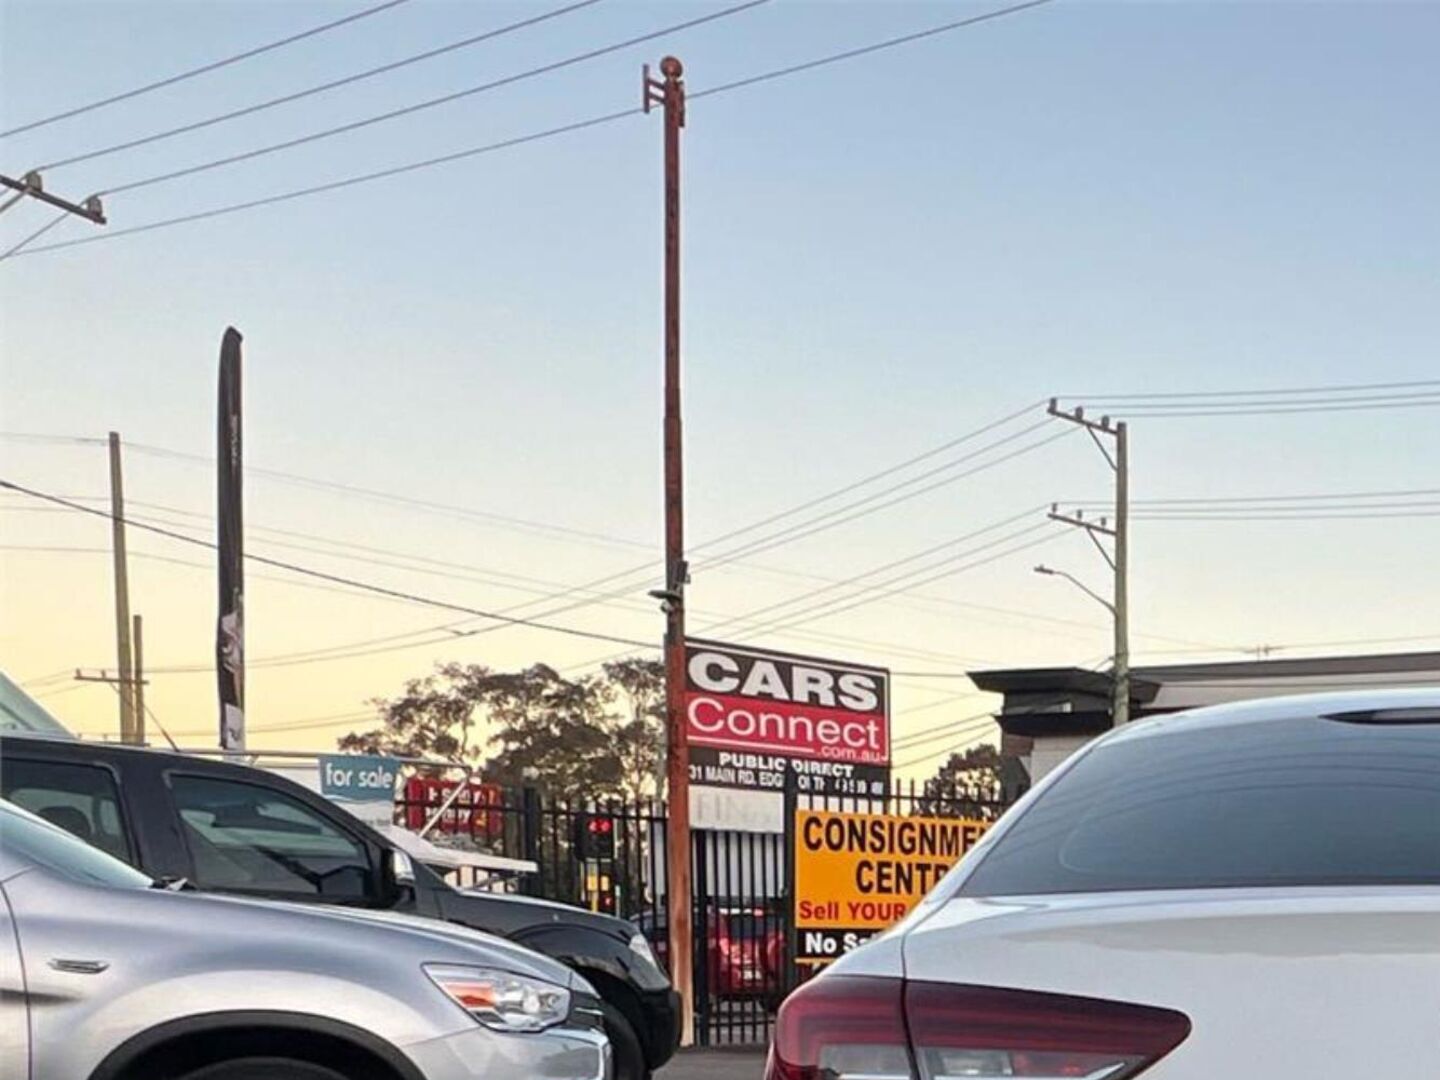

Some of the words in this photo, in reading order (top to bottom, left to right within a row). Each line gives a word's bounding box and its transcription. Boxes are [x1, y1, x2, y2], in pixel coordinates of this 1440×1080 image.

[688, 652, 878, 711] CARS
[688, 697, 881, 749] Connect
[325, 763, 353, 786] for
[358, 765, 393, 788] sale
[705, 766, 736, 783] MAIN
[719, 752, 786, 771] PUBLIC
[792, 759, 854, 778] DIRECT
[803, 816, 989, 857] CONSIGNME
[799, 901, 839, 920] Sell
[847, 902, 907, 921] YOUR
[805, 932, 837, 953] No
